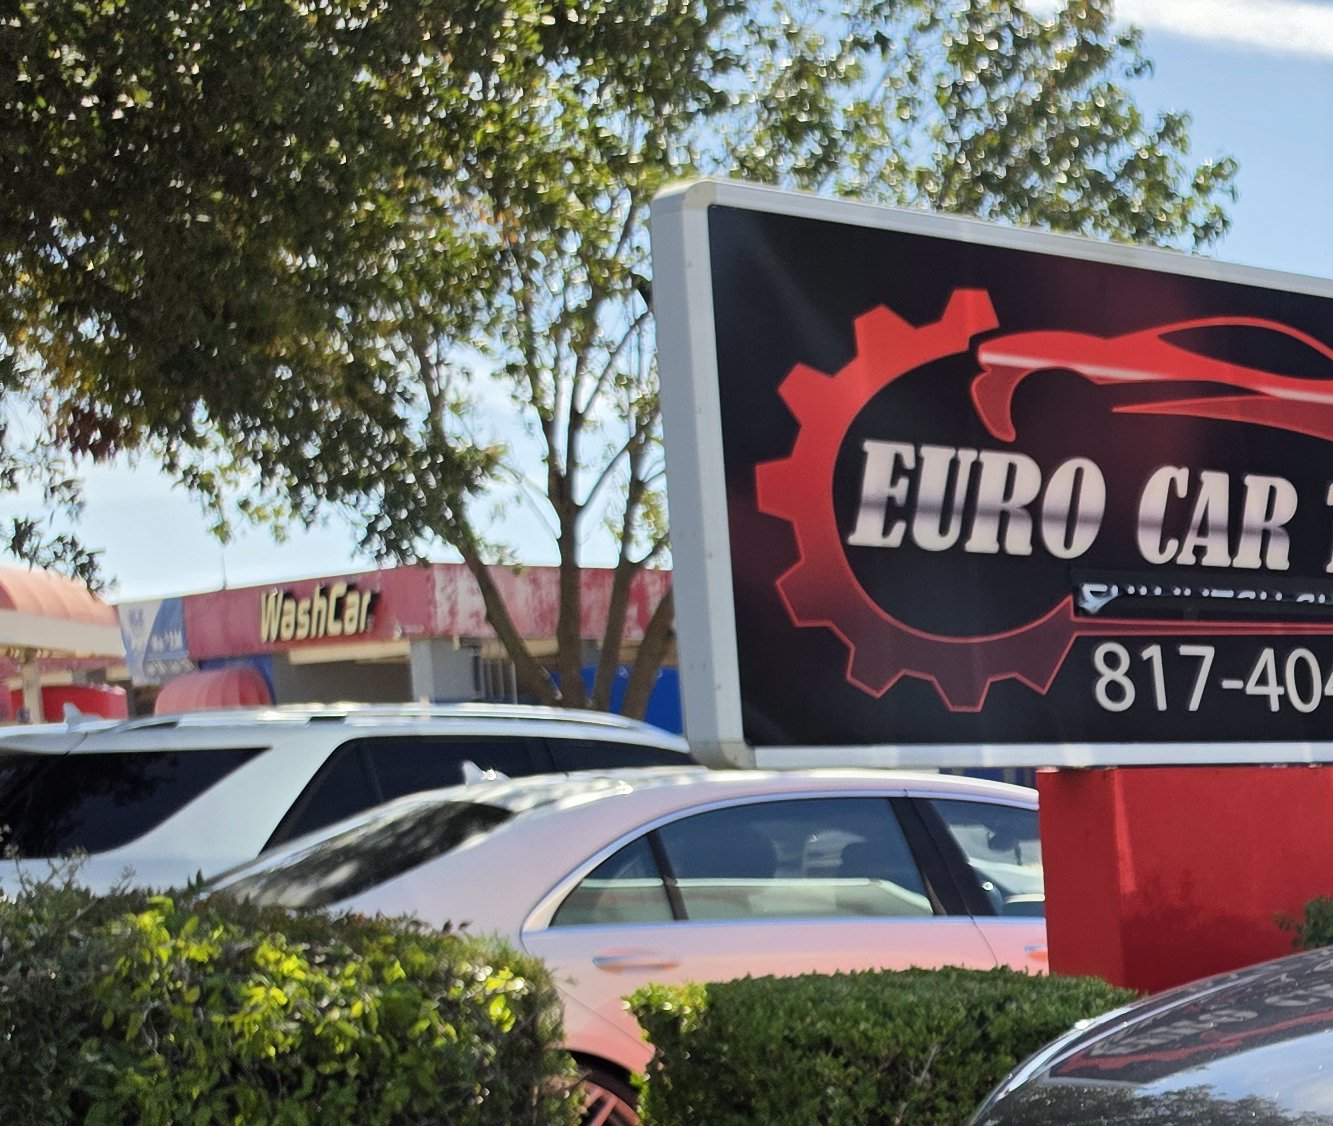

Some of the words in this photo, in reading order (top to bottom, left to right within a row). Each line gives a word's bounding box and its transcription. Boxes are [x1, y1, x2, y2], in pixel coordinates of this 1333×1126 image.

[847, 440, 1107, 559] EURO
[1137, 464, 1301, 573] CAR
[261, 581, 372, 644] WashCar
